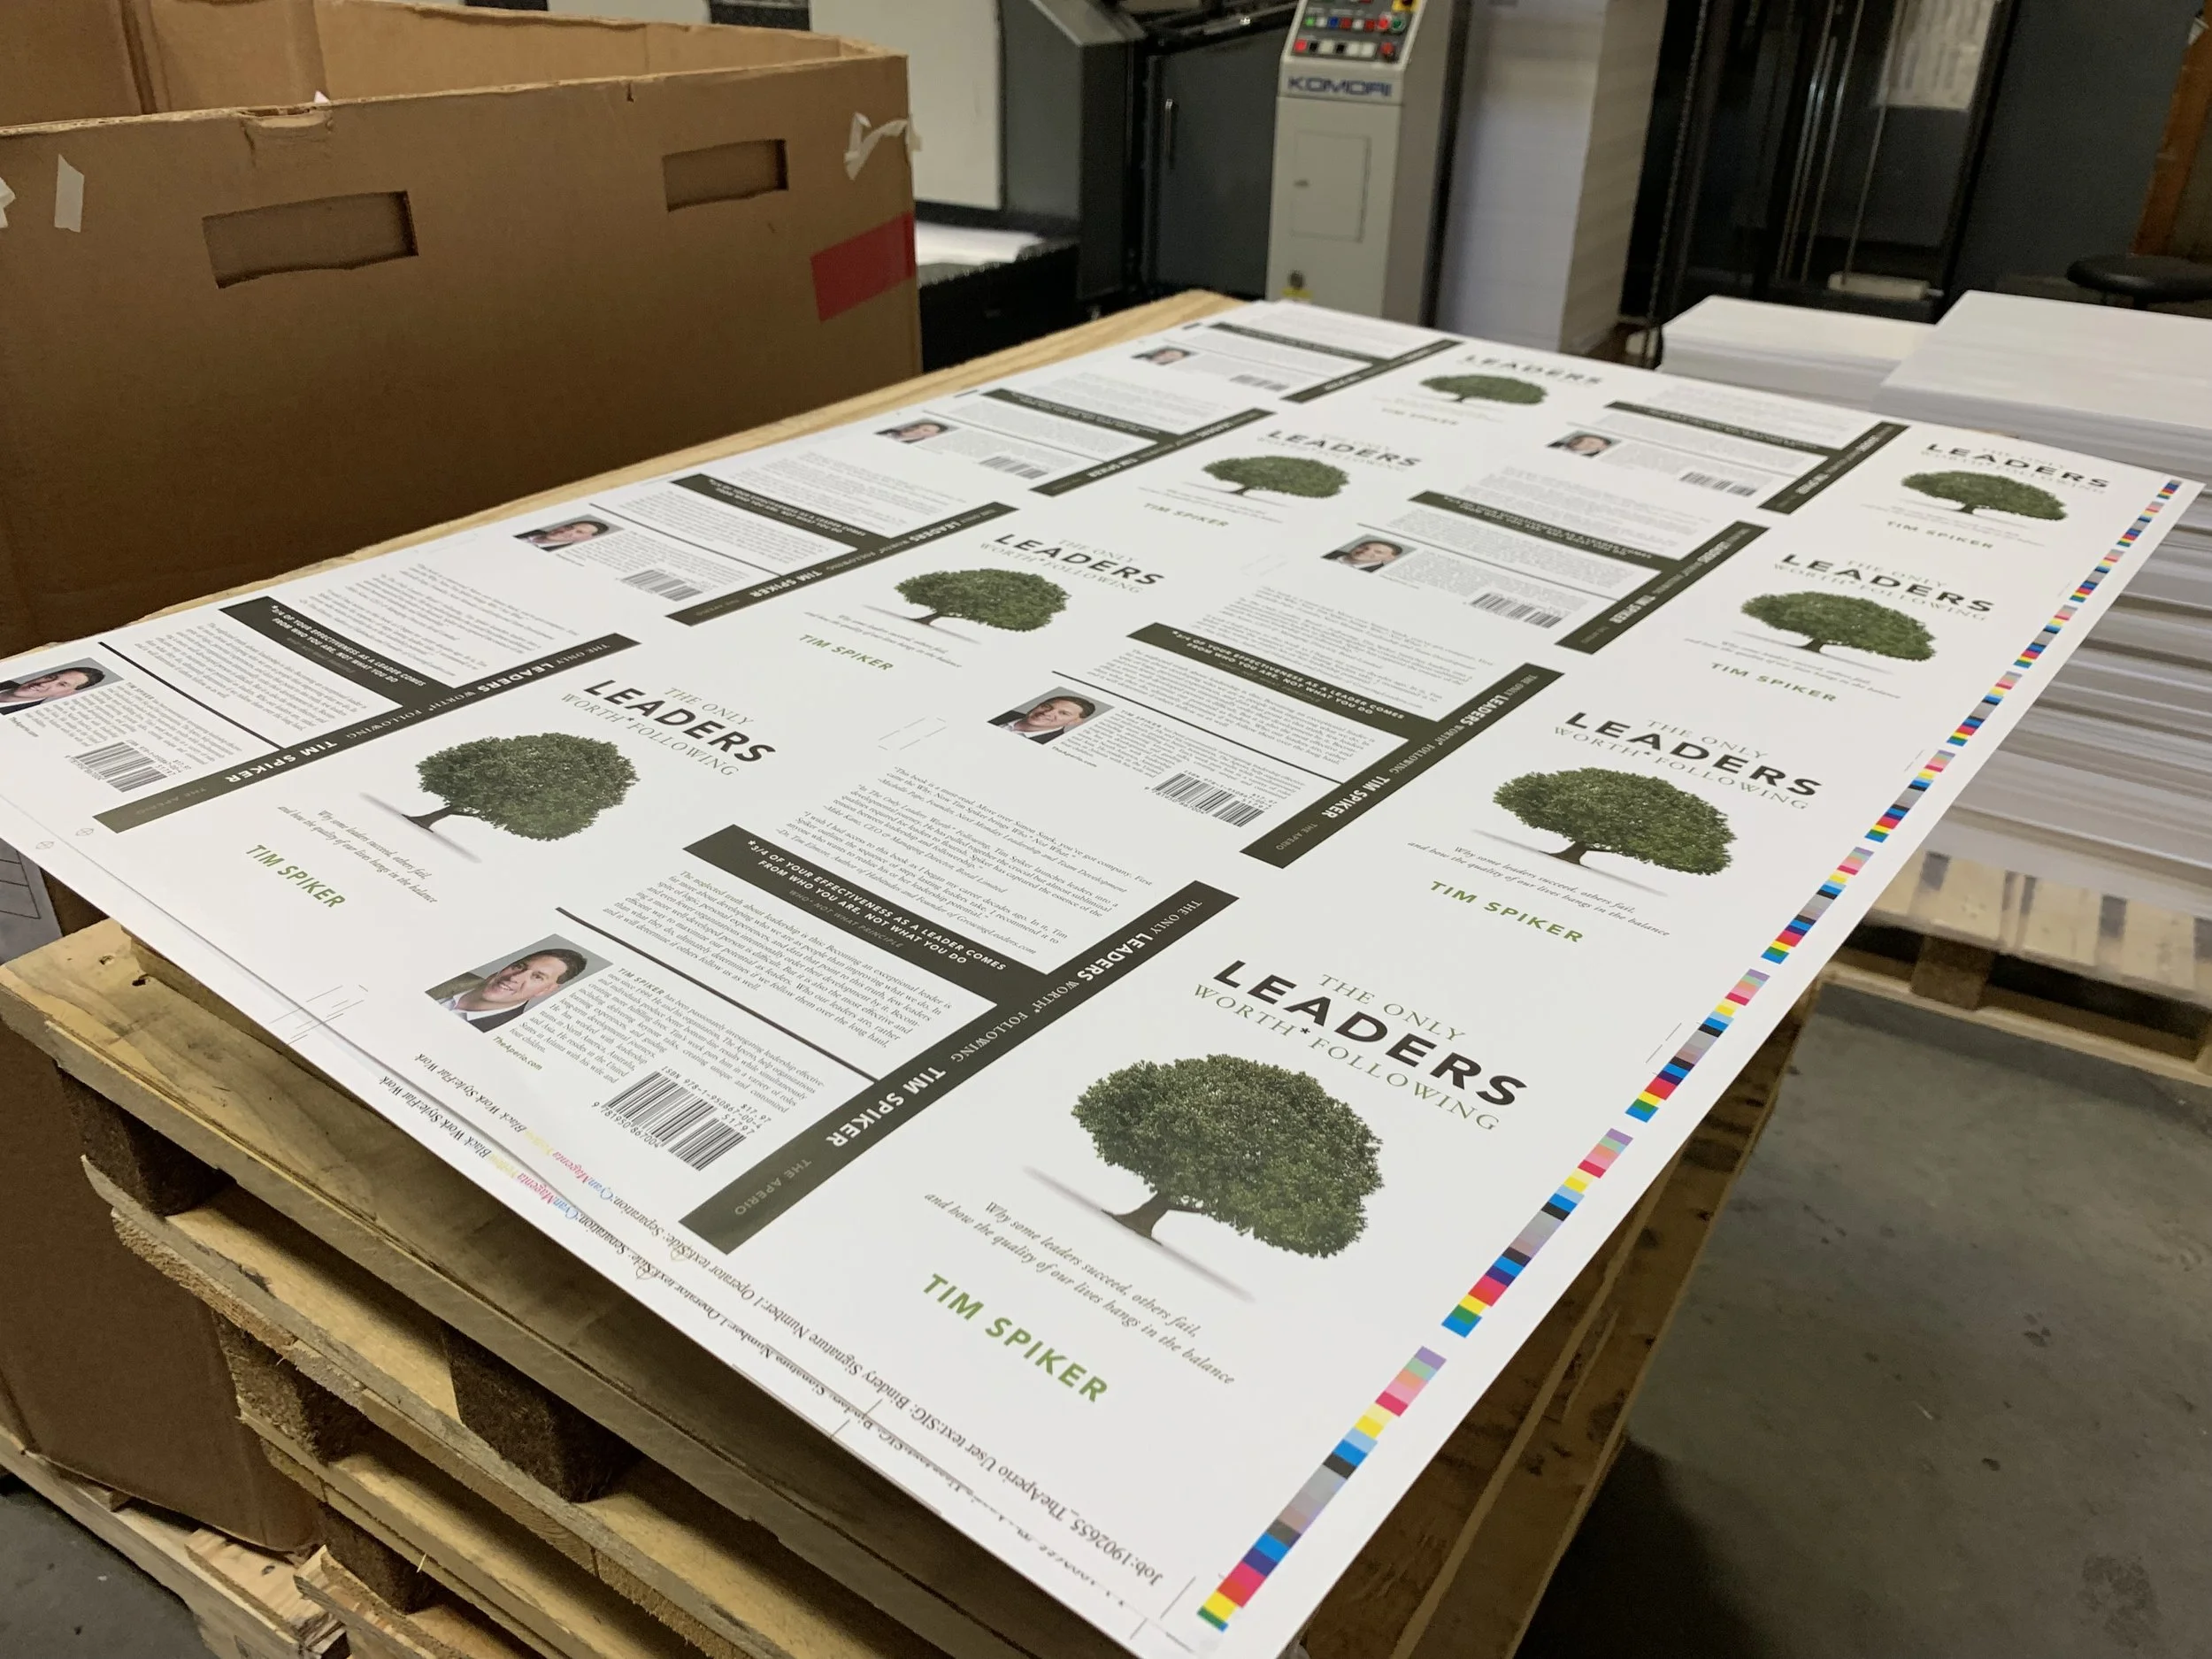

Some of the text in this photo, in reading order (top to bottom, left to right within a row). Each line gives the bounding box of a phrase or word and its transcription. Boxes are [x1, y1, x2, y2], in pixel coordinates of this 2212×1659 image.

[1287, 76, 1393, 97] KOMORI
[1267, 430, 1421, 467] LEADERS
[1926, 443, 2108, 488] LEADERS
[994, 534, 1164, 585] LEADERS
[1782, 554, 1993, 612] LEADERS
[477, 662, 555, 693] LEADERS
[799, 634, 894, 671] TIM SPIKER
[664, 687, 755, 726] THE ONLY
[1711, 663, 1837, 702] TIM SPIKER
[345, 709, 423, 739] FOLLOWING
[583, 680, 776, 763] LEADERS
[1459, 694, 1509, 726] LEADERS
[224, 741, 338, 783] TIM SPIKER
[626, 722, 740, 776] FOLLOWING
[1388, 743, 1436, 774] FOLLOWING
[1565, 711, 1822, 796] LEADERS
[1647, 719, 1768, 759] THE ONLY
[1321, 775, 1391, 818] TIM SPIKER
[245, 844, 346, 908] TIM SPIKER
[1407, 842, 1431, 851] and
[1428, 848, 1450, 858] how
[1467, 863, 1504, 878] quality
[1536, 885, 1562, 897] lives
[1561, 894, 1593, 908] hangs
[1608, 911, 1626, 920] the
[1627, 918, 1671, 936] balance
[1454, 846, 1636, 914] Why some leaders succeed, others fail,
[757, 860, 967, 964] FROM WHO YOU ARE, NOT WHAT YOU DO
[769, 854, 786, 863] OF
[785, 861, 814, 878] YOUR
[813, 876, 894, 918] EFFECTIVENESS
[893, 916, 910, 926] AS
[920, 928, 964, 951] LEADER
[965, 949, 1007, 971] COMES
[1150, 914, 1180, 934] ONLY
[1177, 900, 1202, 915] THE
[1430, 880, 1584, 943] TIM SPIKER
[1077, 933, 1154, 981] LEADERS
[1212, 959, 1527, 1106] LEADERS
[1319, 973, 1466, 1041] THE ONLY
[950, 1011, 1028, 1062] FOLLOWING
[826, 1067, 947, 1147] TIM SPIKER
[1309, 1037, 1500, 1130] FOLLOWING
[721, 1113, 756, 1135] 51797
[733, 1159, 812, 1216] THE APERIO
[924, 1194, 1235, 1384] and how the quality of our lives hangs in the balance
[985, 1201, 1202, 1338] Why some leaders succeed, others fail,
[923, 1273, 1108, 1402] TIM SPIKER
